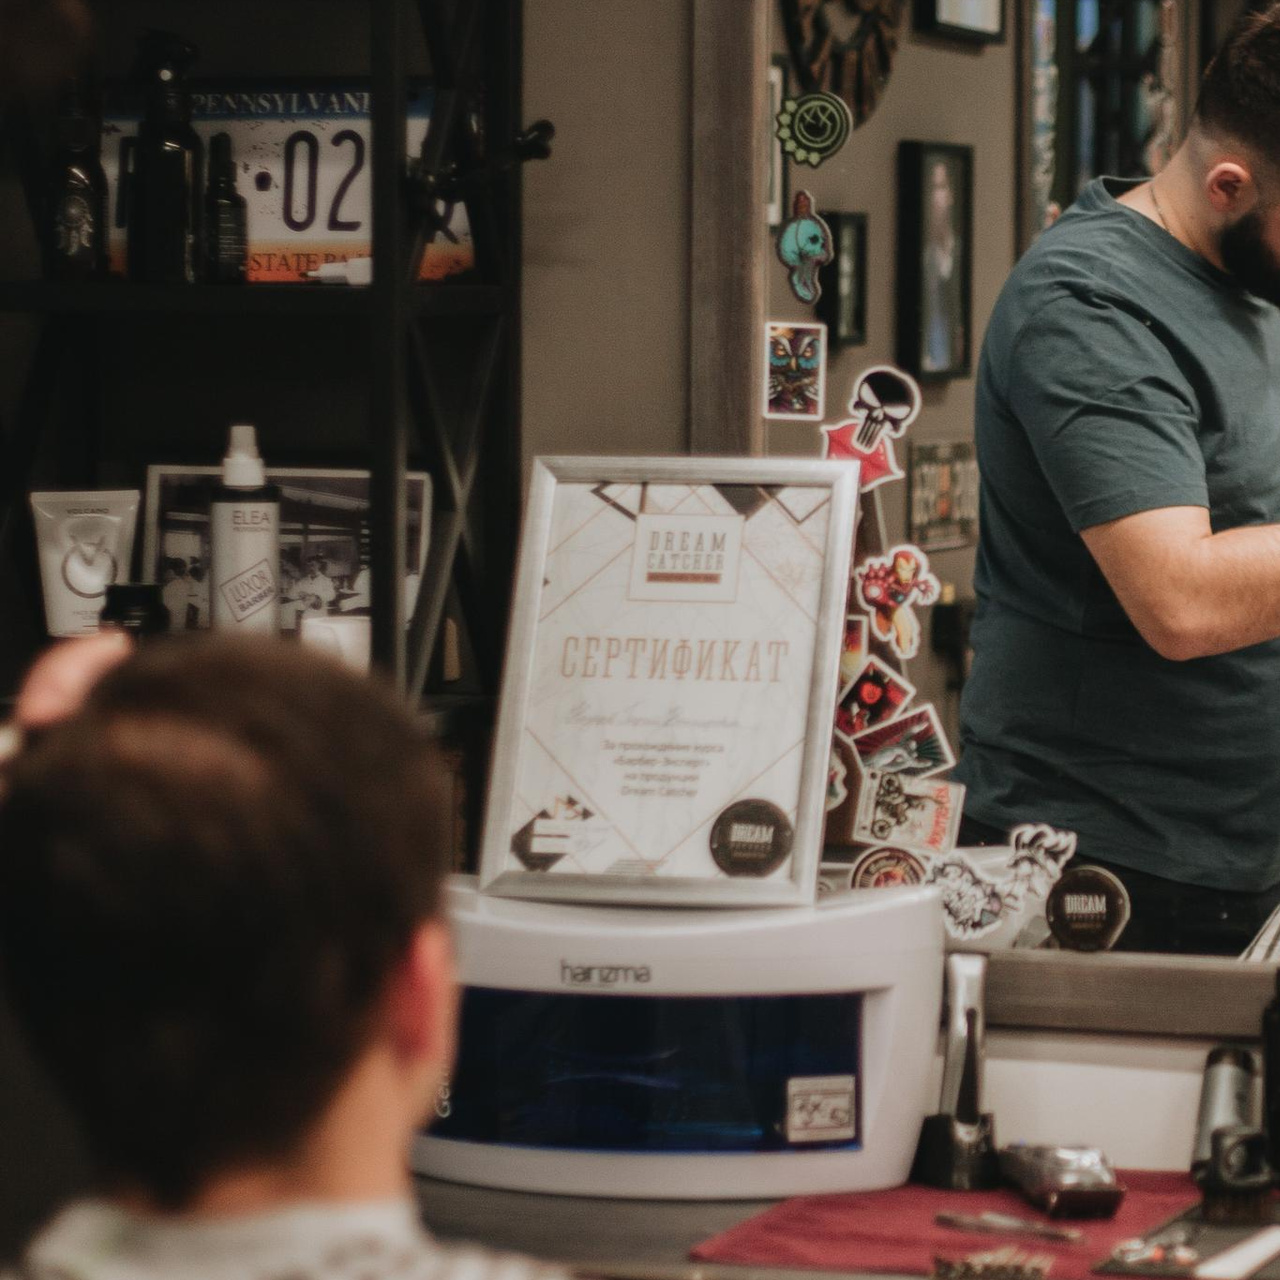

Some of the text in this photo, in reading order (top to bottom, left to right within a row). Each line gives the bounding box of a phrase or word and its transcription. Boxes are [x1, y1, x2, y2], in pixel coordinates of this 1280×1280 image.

[191, 92, 372, 115] PENNSYLVANI
[650, 530, 727, 552] DREAM
[646, 553, 725, 571] CATCHER
[560, 635, 790, 683] СЕРТИФИКАТ
[560, 958, 652, 984] harizma
